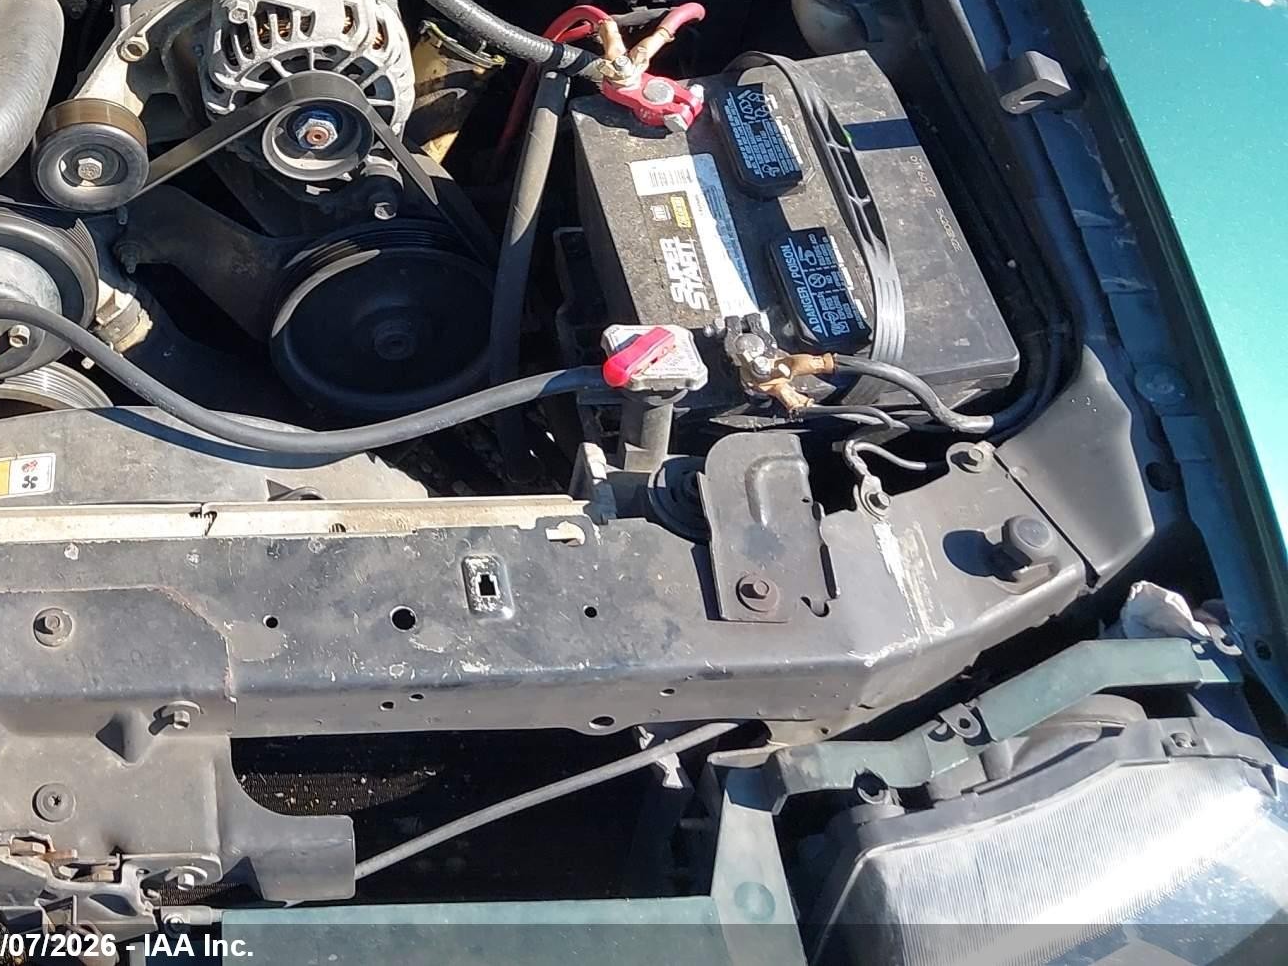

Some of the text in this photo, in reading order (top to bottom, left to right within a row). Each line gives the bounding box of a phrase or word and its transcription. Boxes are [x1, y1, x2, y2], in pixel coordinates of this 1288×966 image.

[659, 239, 686, 304] SUPER
[673, 235, 710, 309] START
[780, 244, 801, 278] POISON
[796, 285, 820, 325] DANGER
